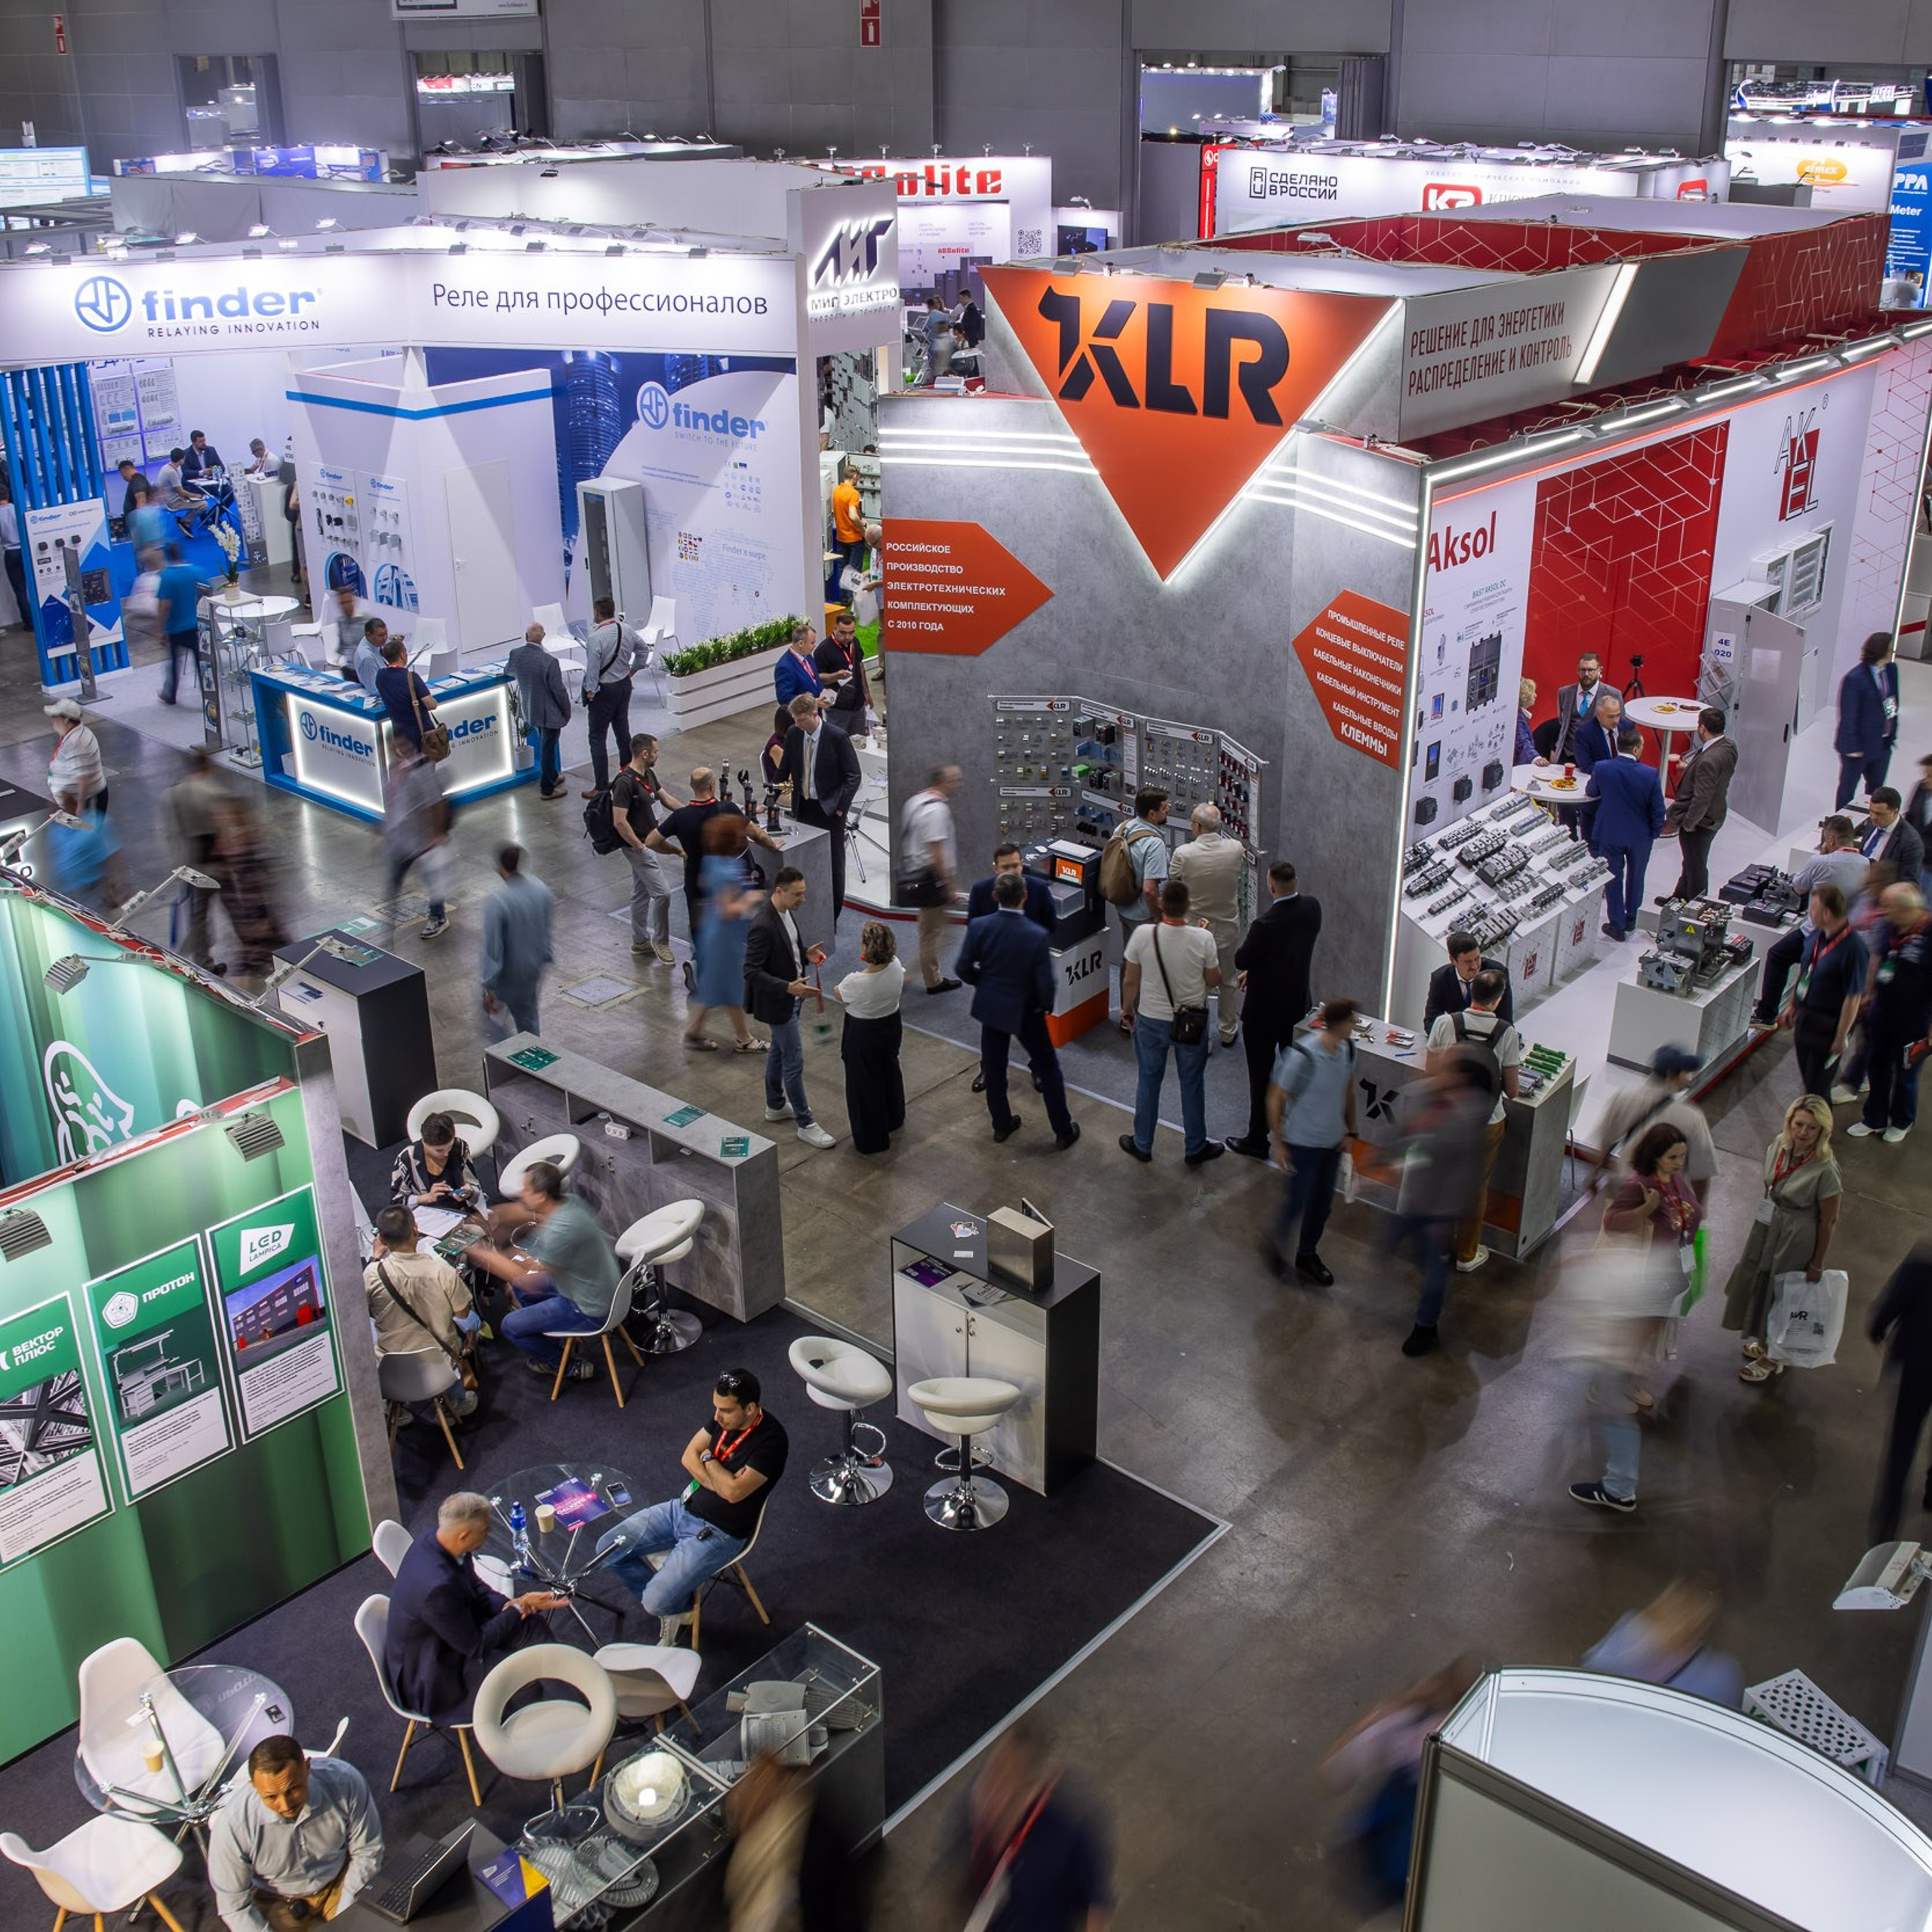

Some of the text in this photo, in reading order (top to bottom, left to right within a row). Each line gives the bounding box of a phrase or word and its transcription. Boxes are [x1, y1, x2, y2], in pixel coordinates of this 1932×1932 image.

[1269, 172, 1338, 187] СДЕЛАНО
[142, 287, 315, 321] finder
[432, 283, 768, 317] Реле для профессионалов
[811, 287, 897, 311] МИГ ЭЛЕКТРО
[148, 320, 321, 338] RELAYING INNOVATION
[1411, 302, 1565, 358] РЕШЕНИЕ ДЛЯ ЭНЕРГЕТИКИ
[1038, 285, 1291, 426] KLR
[1408, 334, 1572, 397] РАСПРЕДЕЛЕНИЕ И КОНТРОЛЬ
[672, 401, 766, 439] finder
[675, 432, 758, 452] SWITCH TO THE FUTURE
[886, 542, 951, 554] РОССИЙСКОЕ
[1428, 510, 1497, 573] Aksol
[887, 562, 964, 574] ПРОИЗВОДСТВО
[887, 581, 1006, 596] ЭЛЕКТРОТЕХНИЧЕСКИХ
[888, 601, 974, 614] КОМПЛЕКТУЮЩИХ
[897, 620, 917, 629] 2010
[919, 621, 944, 632] ГОДА
[1327, 609, 1405, 651] ПРОМЫШЛЕННЫЕ РЕЛЕ
[1315, 626, 1404, 674] КОНЦЕВЫЕ ВЫКЛЮЧАТЕЛИ
[1713, 648, 1732, 659] 020
[1313, 648, 1401, 697] КАБЕЛЬНЫЕ НАКОНЕЧНИКИ
[1316, 670, 1400, 718] КАБЕЛЬНЫЙ ИНСТРУМЕНТ
[1332, 700, 1398, 741] КАБЕЛЬНЫЕ ВВОДЫ
[319, 724, 374, 757] finder
[459, 730, 499, 747] INNOVATION
[1340, 721, 1388, 757] КЛЕММЫ
[1065, 949, 1103, 986] KLR
[249, 1243, 282, 1263] LAMPICA
[142, 1271, 195, 1303] ПРОТОН
[12, 1326, 64, 1356] ВЕКТОР
[14, 1340, 57, 1367] ПЛЮС
